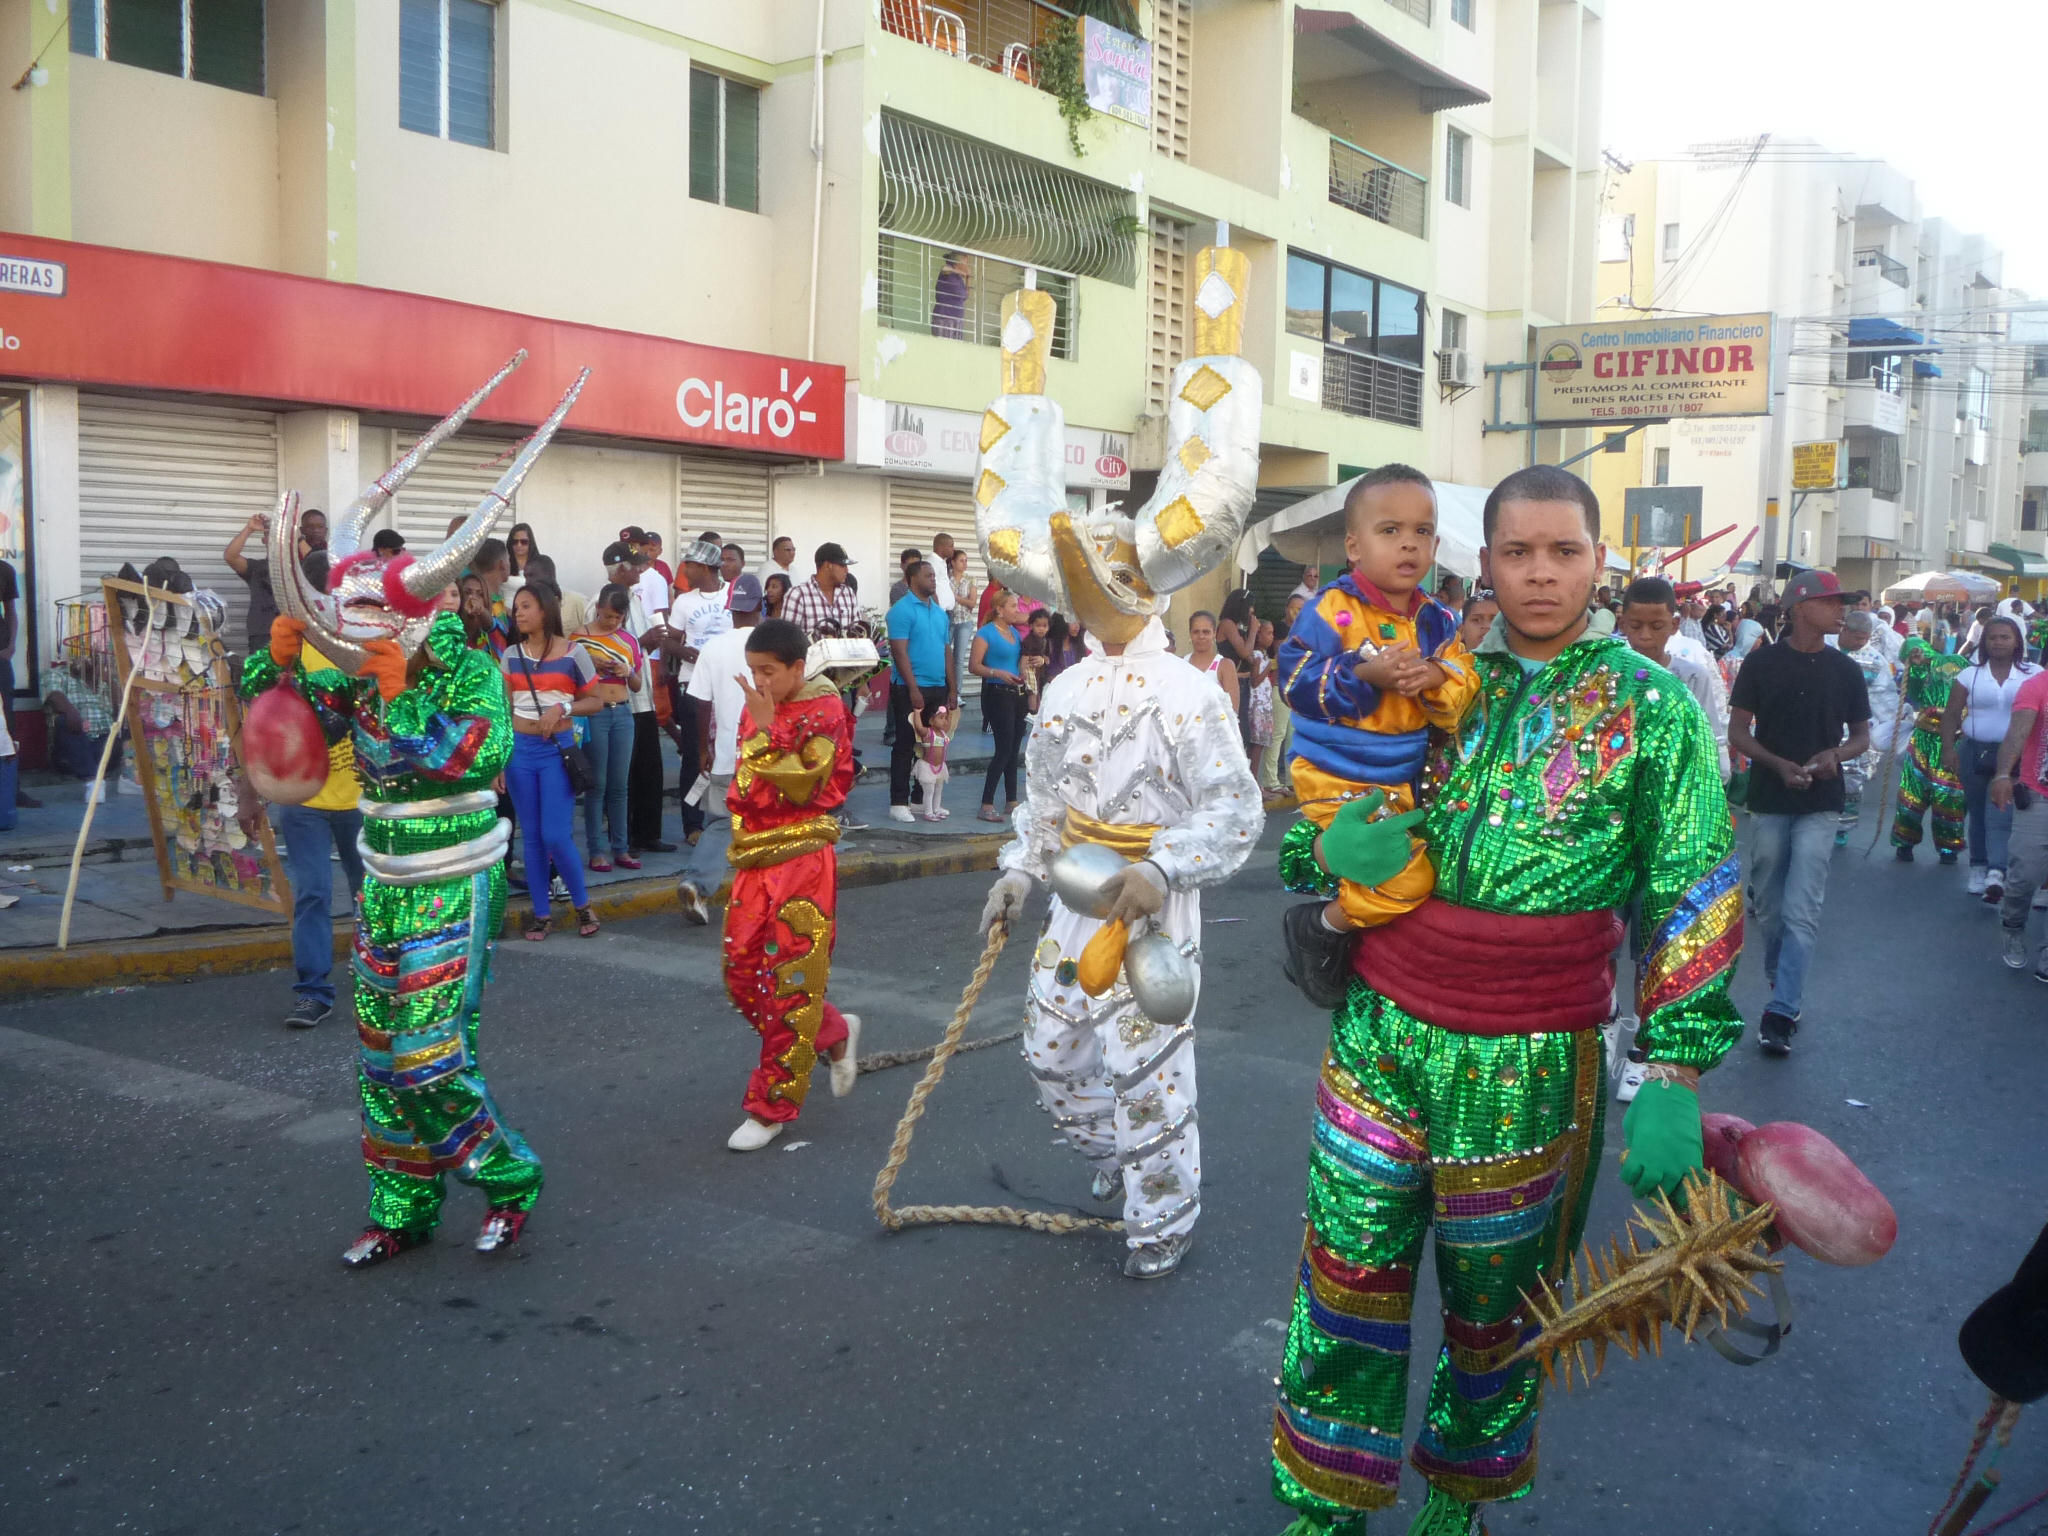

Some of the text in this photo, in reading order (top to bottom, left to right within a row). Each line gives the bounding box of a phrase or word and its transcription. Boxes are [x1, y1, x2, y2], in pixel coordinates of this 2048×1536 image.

[1088, 33, 1147, 80] Sonia
[1581, 324, 1764, 347] Centro Inmobiliario Financiero
[1593, 345, 1754, 379] CIFINOR
[1553, 384, 1628, 395] PRESTAMOS
[1650, 379, 1748, 390] COMERCIANTE
[676, 377, 795, 438] Claro
[1572, 395, 1615, 405] BIENES
[1619, 393, 1664, 403] RAICES
[1668, 392, 1685, 401] EN
[1591, 407, 1618, 417] TELS.
[1621, 404, 1668, 416] 580-1718
[1679, 403, 1704, 413] 1807
[892, 433, 920, 458] City
[884, 457, 933, 468] COMUNICATION
[1100, 456, 1123, 478] City
